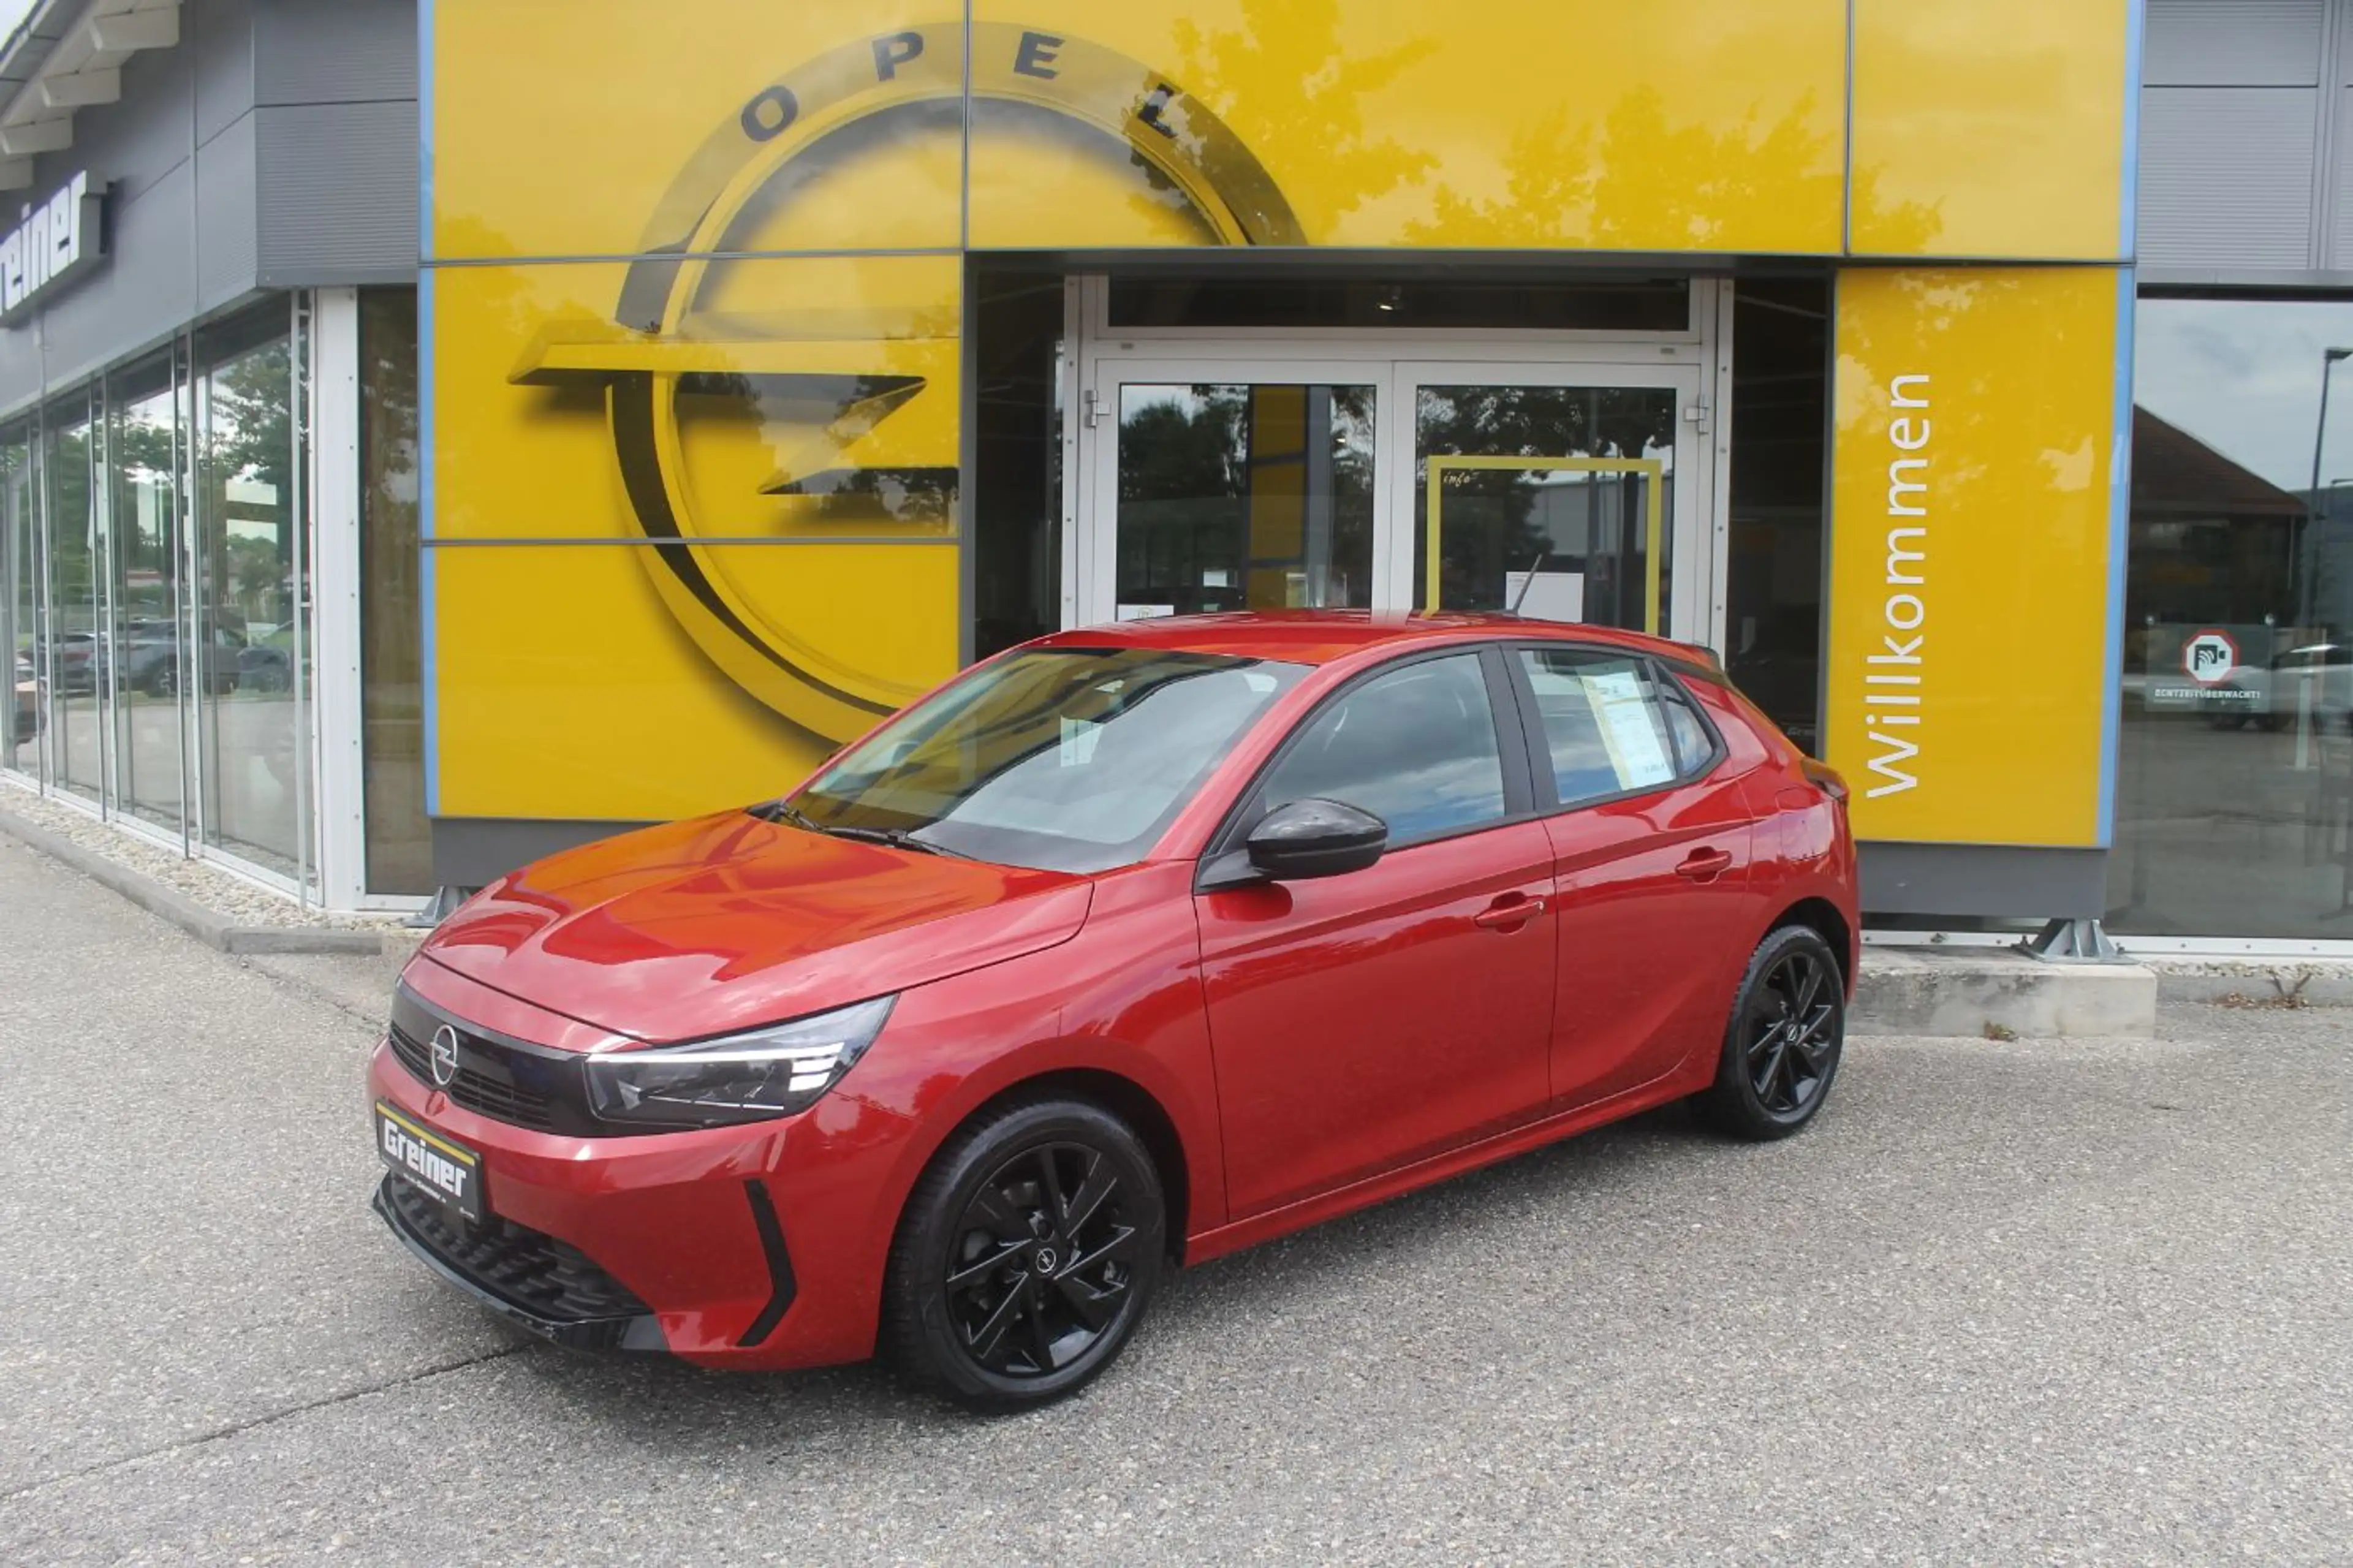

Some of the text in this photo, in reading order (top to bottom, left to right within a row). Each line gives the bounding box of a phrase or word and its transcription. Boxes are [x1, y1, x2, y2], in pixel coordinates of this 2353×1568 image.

[741, 32, 1179, 142] OPEL
[1865, 374, 1930, 798] Willkommen
[385, 1118, 466, 1197] Greiner
